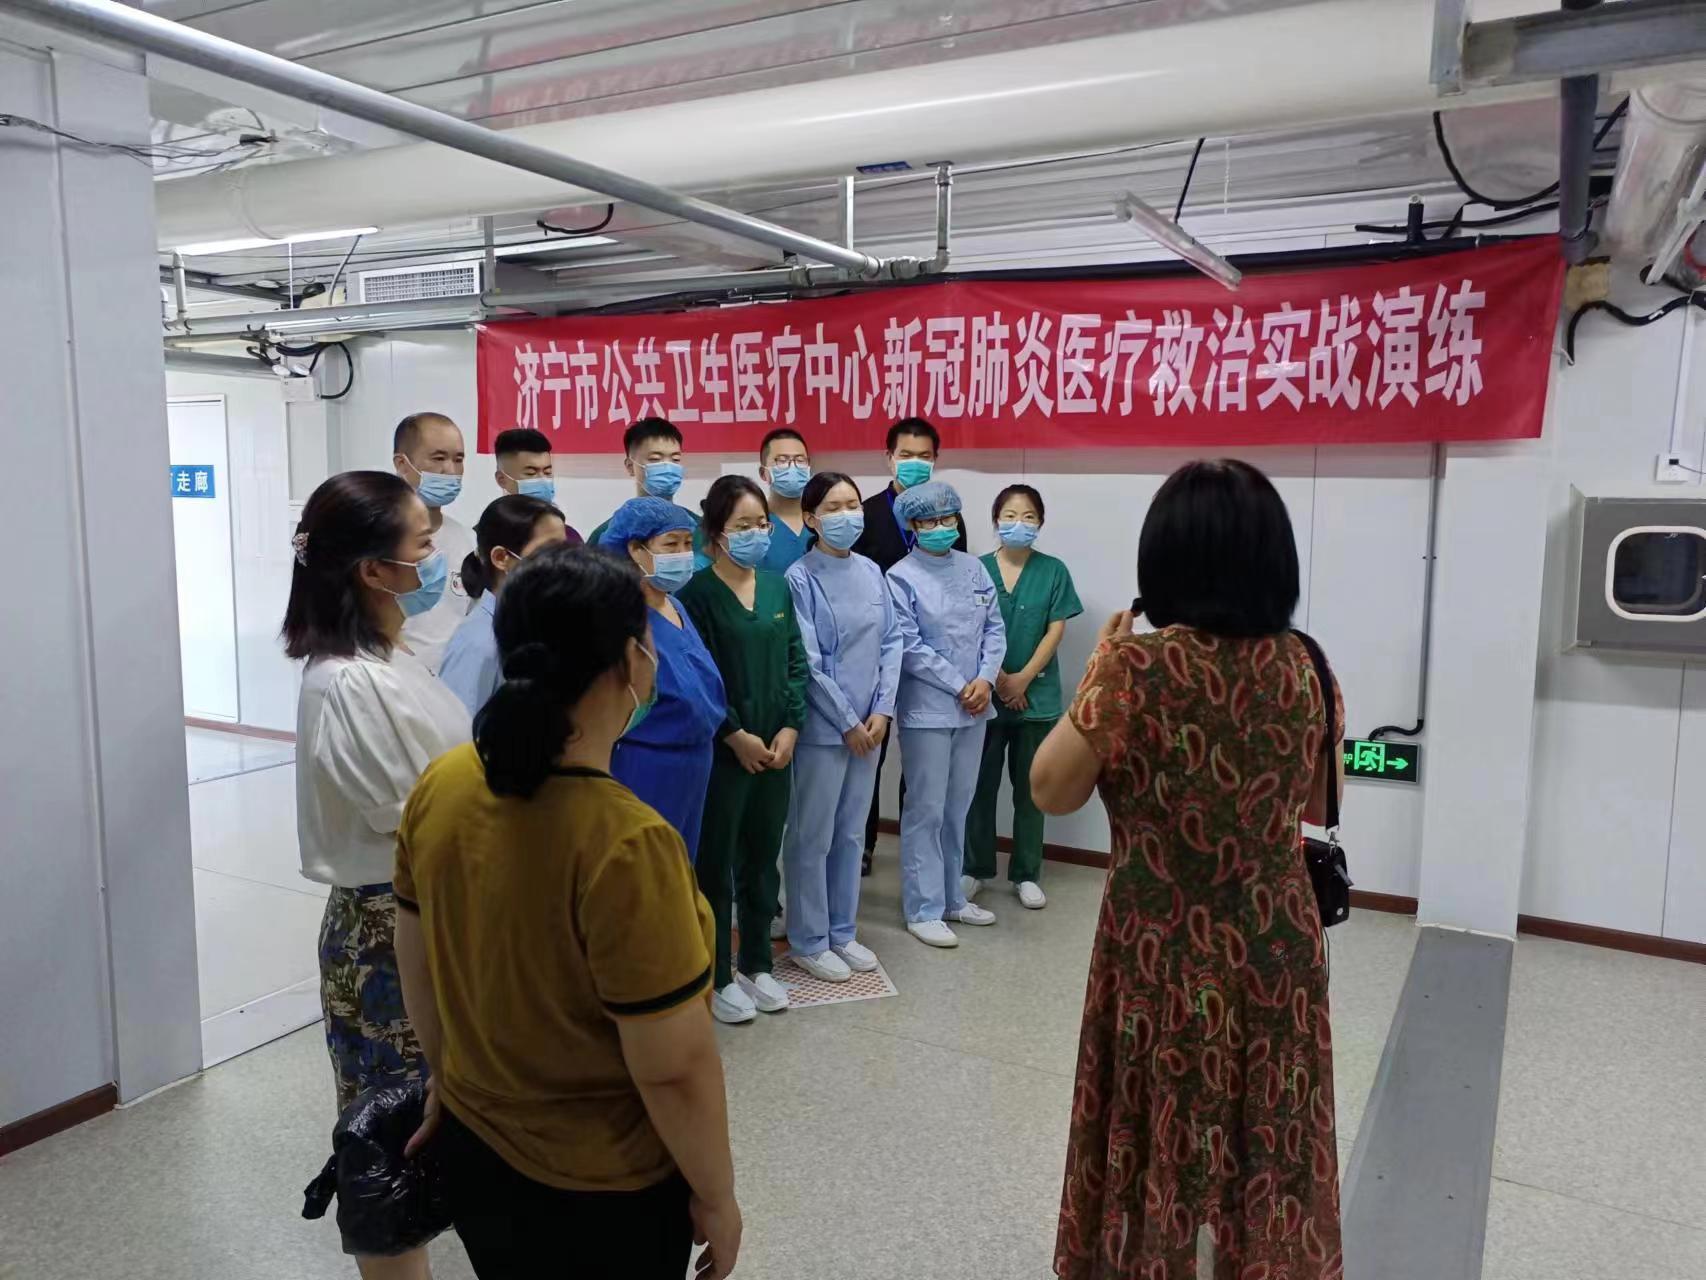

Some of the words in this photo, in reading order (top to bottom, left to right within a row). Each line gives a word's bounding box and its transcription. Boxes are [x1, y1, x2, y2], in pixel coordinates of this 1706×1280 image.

[513, 279, 1486, 430] 济宁市公共卫生医疗中心新冠肺炎医疗救治实战演练
[170, 470, 208, 493] 走廊
